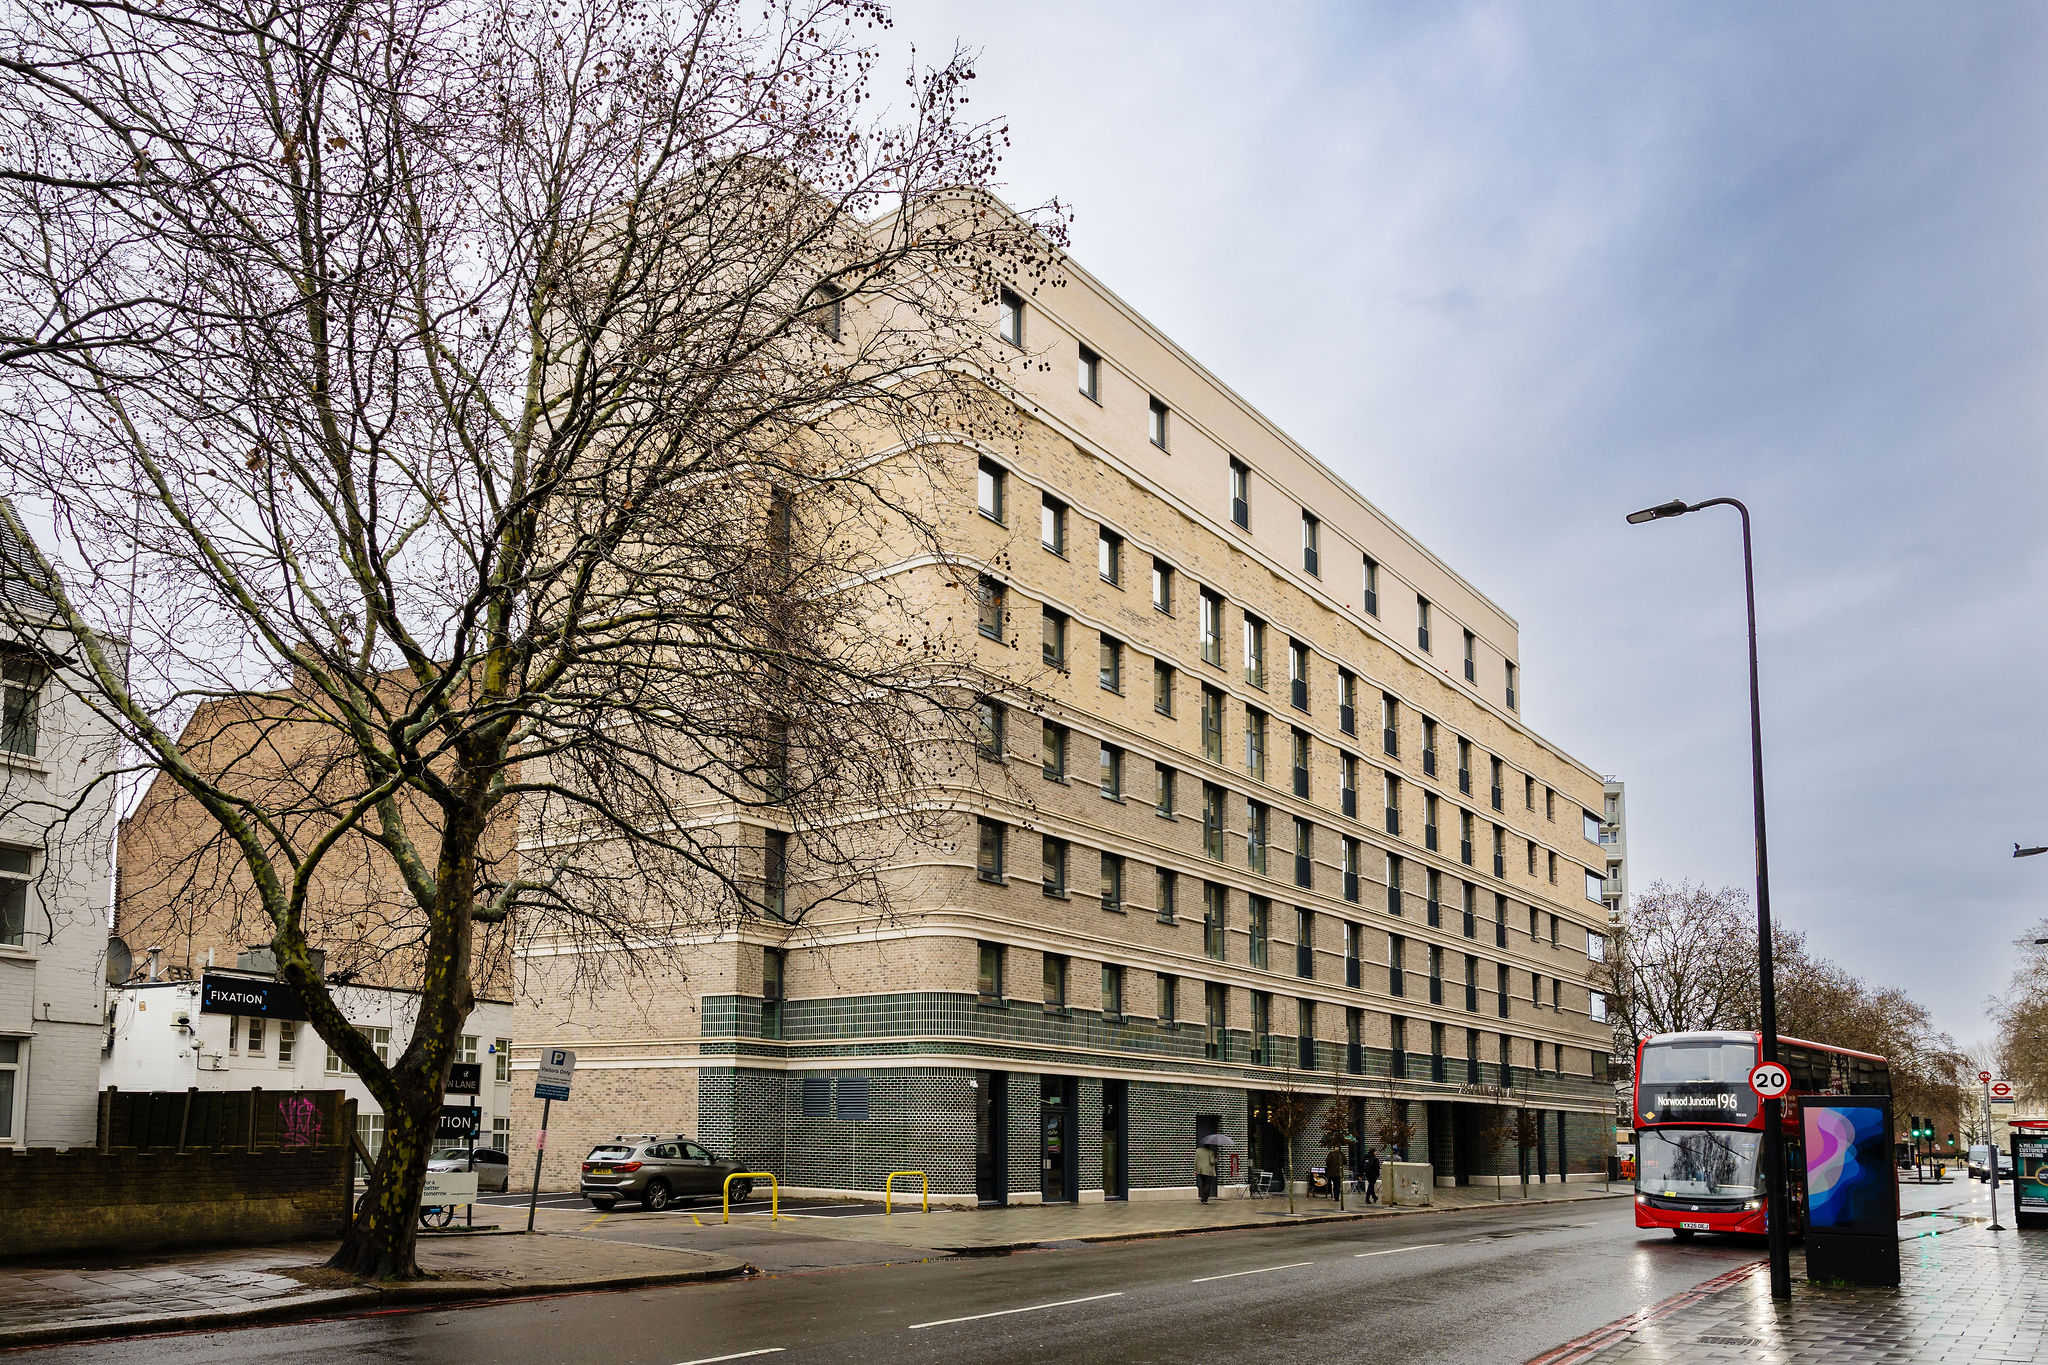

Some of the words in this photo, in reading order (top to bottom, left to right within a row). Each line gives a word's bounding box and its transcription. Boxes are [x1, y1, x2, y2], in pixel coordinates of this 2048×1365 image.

[211, 991, 263, 1005] FIXATION
[559, 1069, 571, 1077] Only
[455, 1080, 476, 1089] LANE
[1756, 1073, 1785, 1087] 20
[1657, 1096, 1688, 1106] Norwood
[1689, 1096, 1717, 1106] Junction
[1717, 1093, 1738, 1109] 196
[440, 1116, 471, 1129] TION
